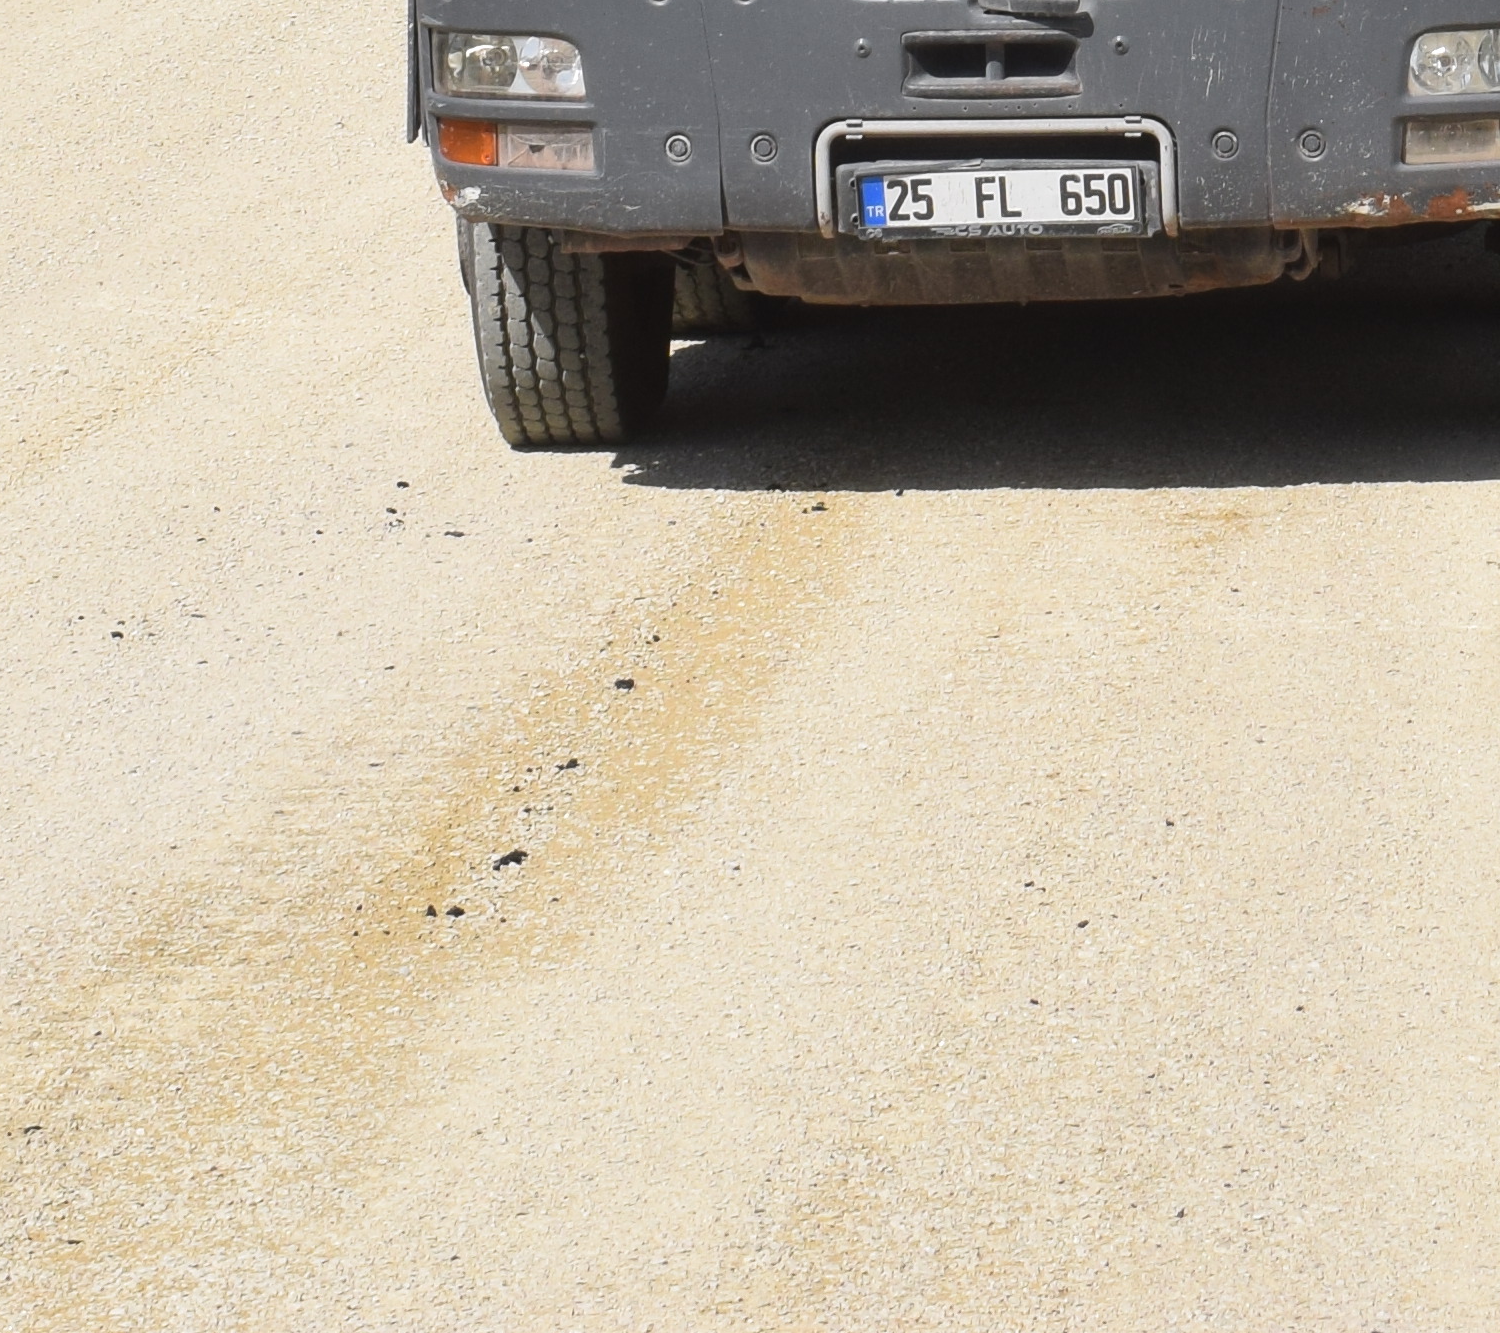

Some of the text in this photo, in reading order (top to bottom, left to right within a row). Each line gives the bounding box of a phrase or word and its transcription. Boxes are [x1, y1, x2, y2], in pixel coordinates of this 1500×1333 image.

[886, 173, 1132, 222] 25 FL 650
[866, 204, 885, 218] TR
[987, 223, 1044, 236] AUTO
